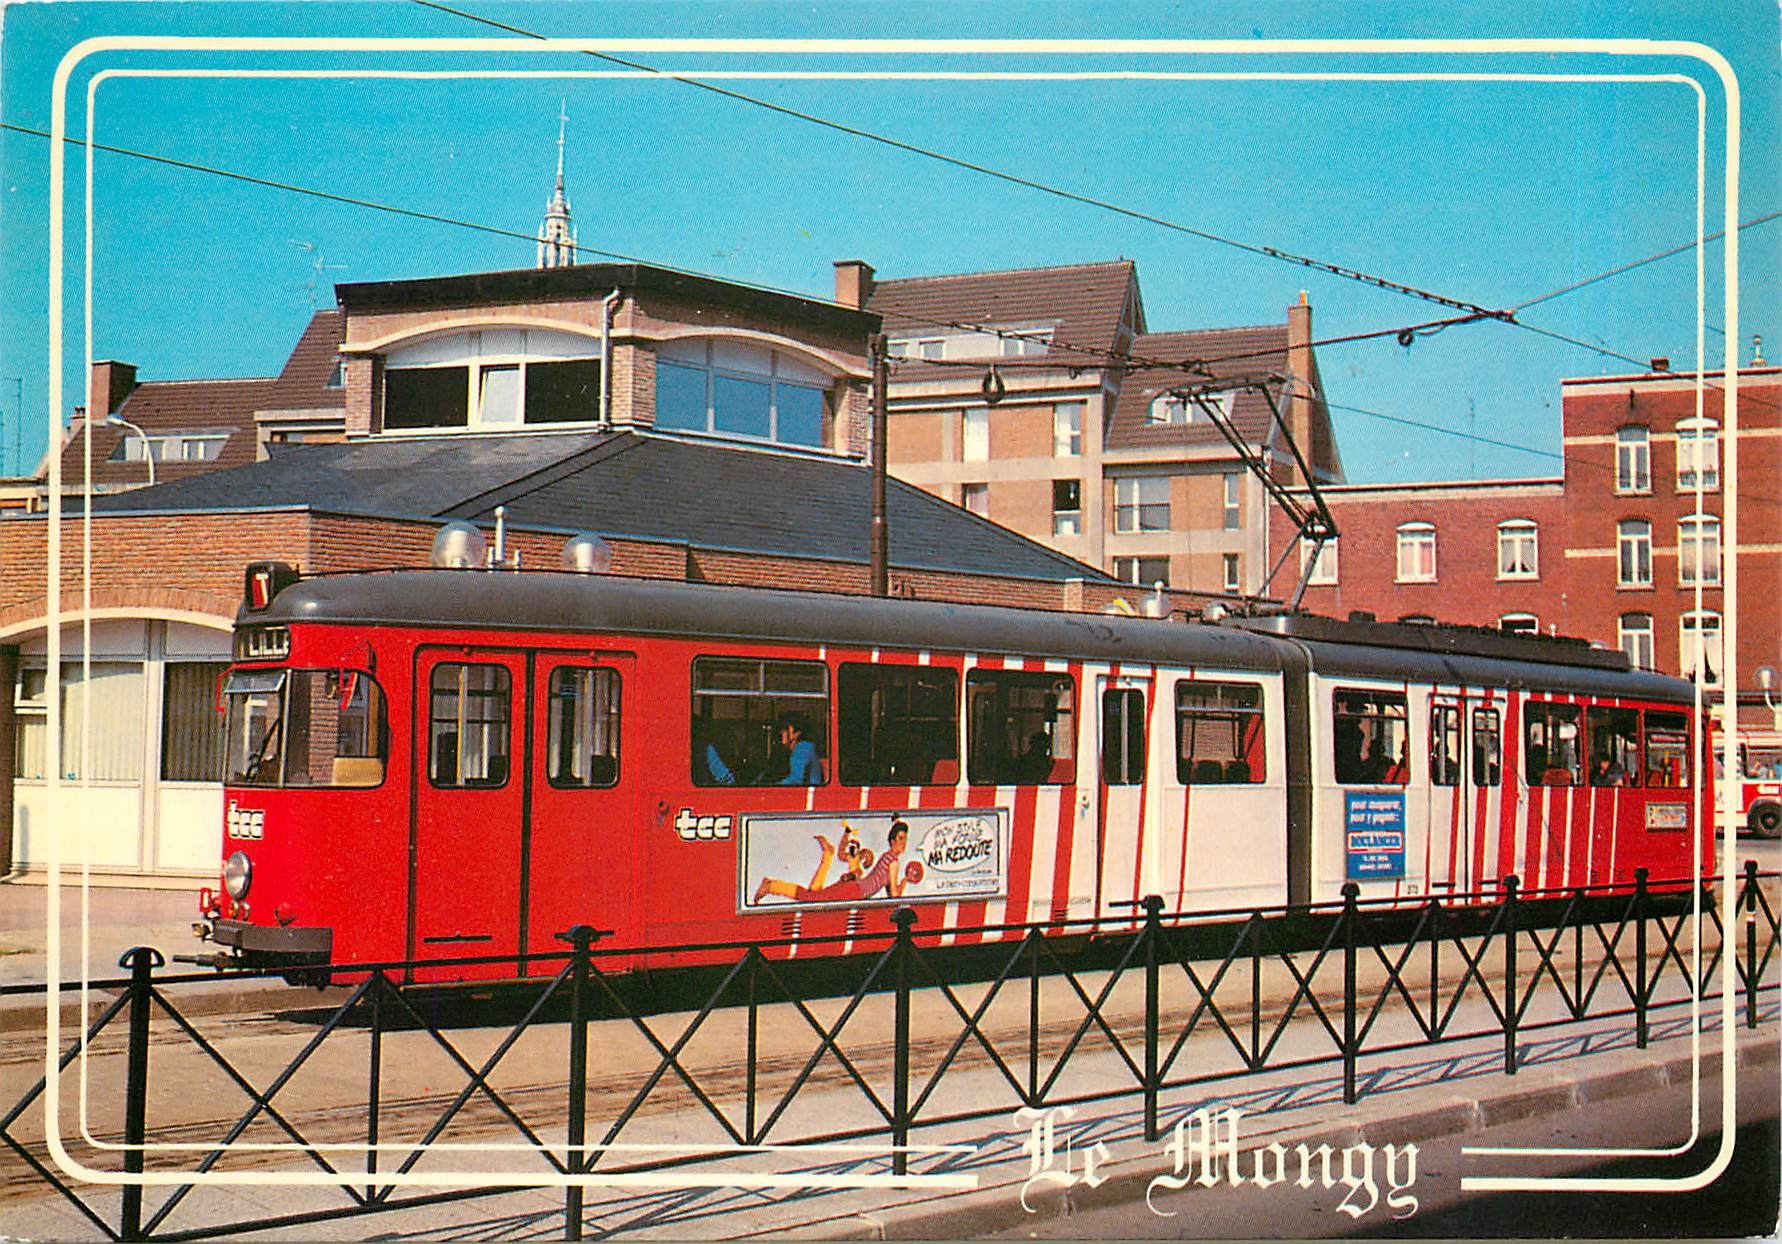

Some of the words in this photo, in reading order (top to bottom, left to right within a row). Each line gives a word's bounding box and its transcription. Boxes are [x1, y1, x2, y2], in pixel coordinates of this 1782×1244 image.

[227, 799, 265, 840] tcc
[674, 808, 732, 842] tcc
[928, 850, 944, 866] MA
[945, 839, 993, 864] REDOUTE
